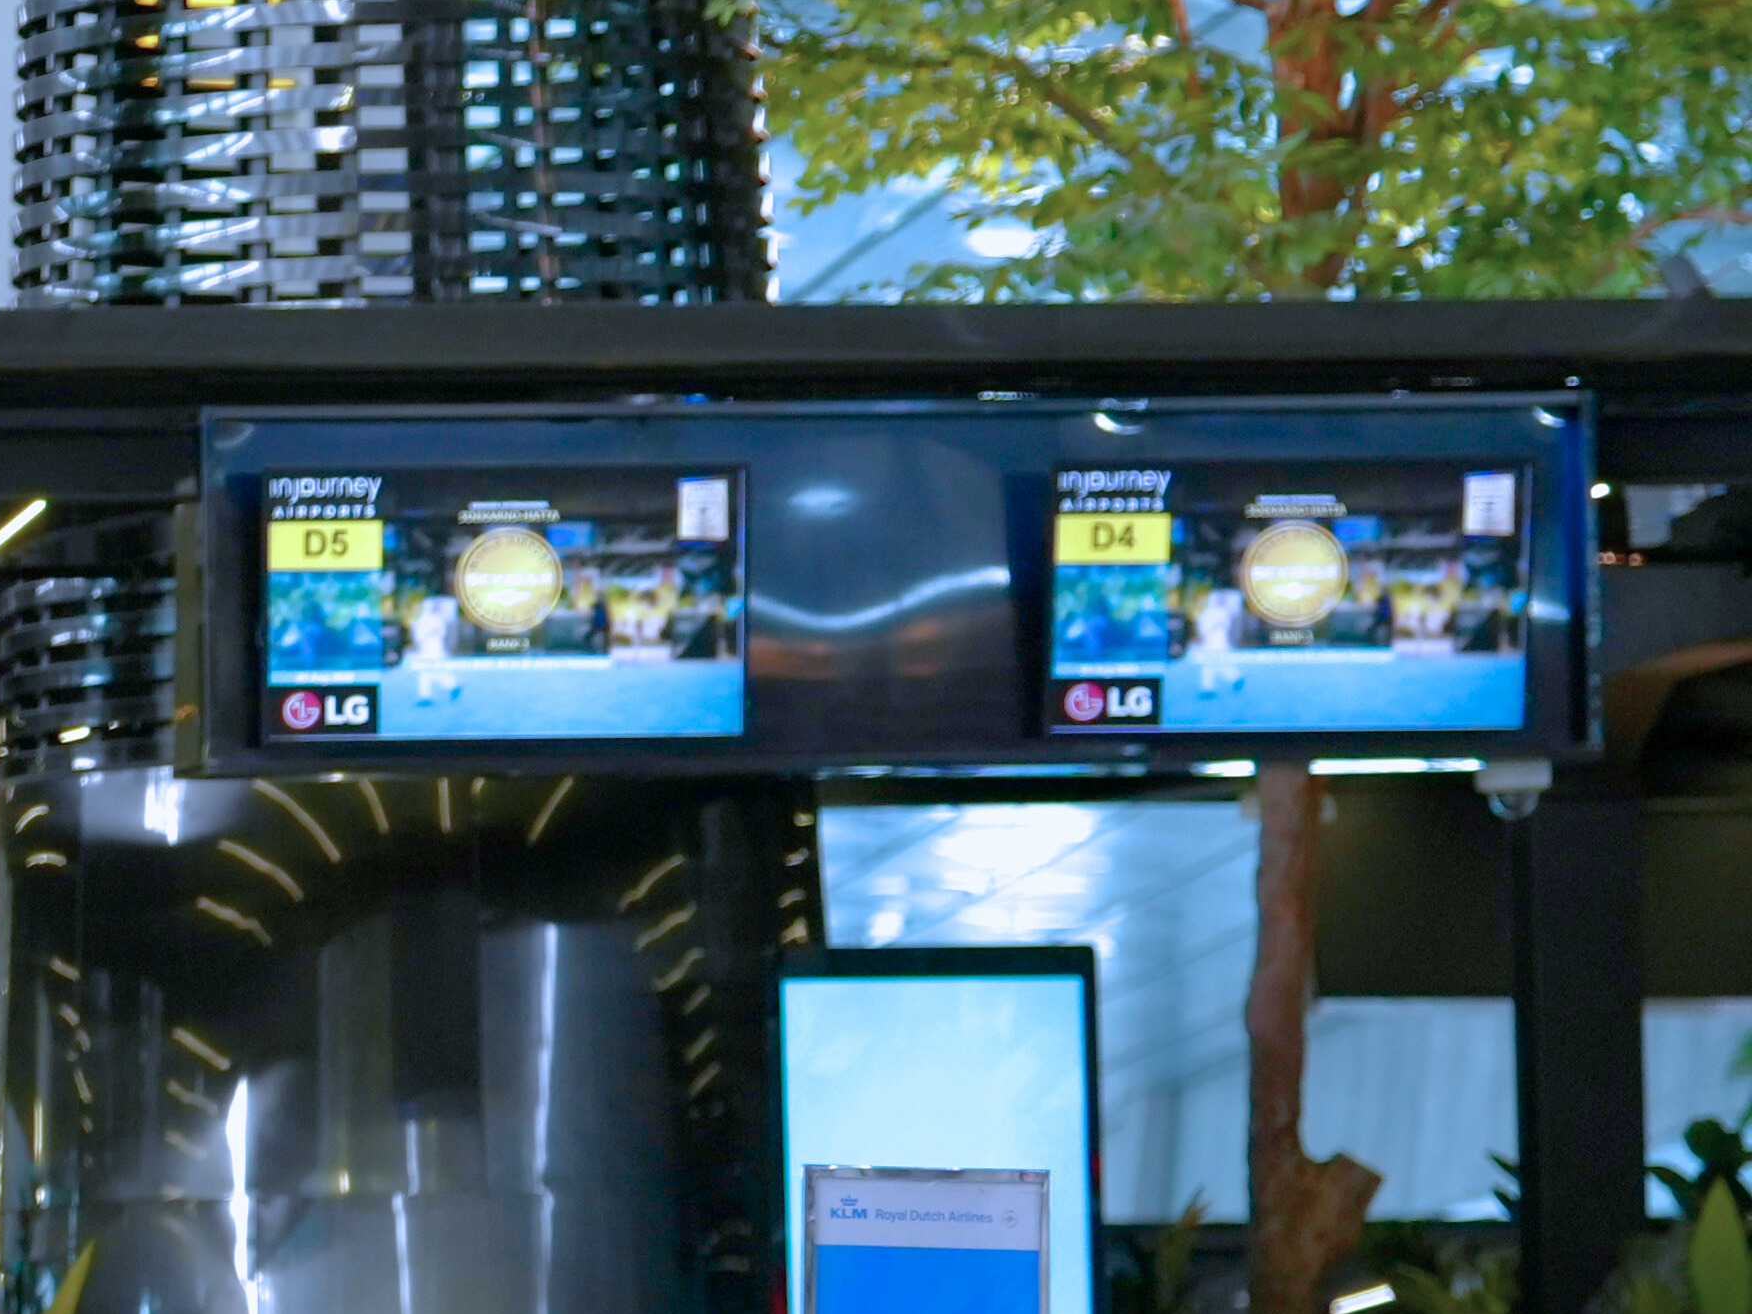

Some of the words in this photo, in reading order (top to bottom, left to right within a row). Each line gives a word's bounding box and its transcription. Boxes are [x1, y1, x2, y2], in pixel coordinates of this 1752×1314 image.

[269, 476, 382, 505] injourney
[1057, 470, 1171, 498] injourney
[303, 528, 350, 557] D5
[1091, 521, 1135, 550] D4
[324, 695, 369, 725] LG
[1106, 686, 1152, 717] LG
[830, 1208, 868, 1220] KLM
[875, 1209, 907, 1223] Royal
[910, 1210, 944, 1222] Dutch
[948, 1211, 993, 1223] Airlines
